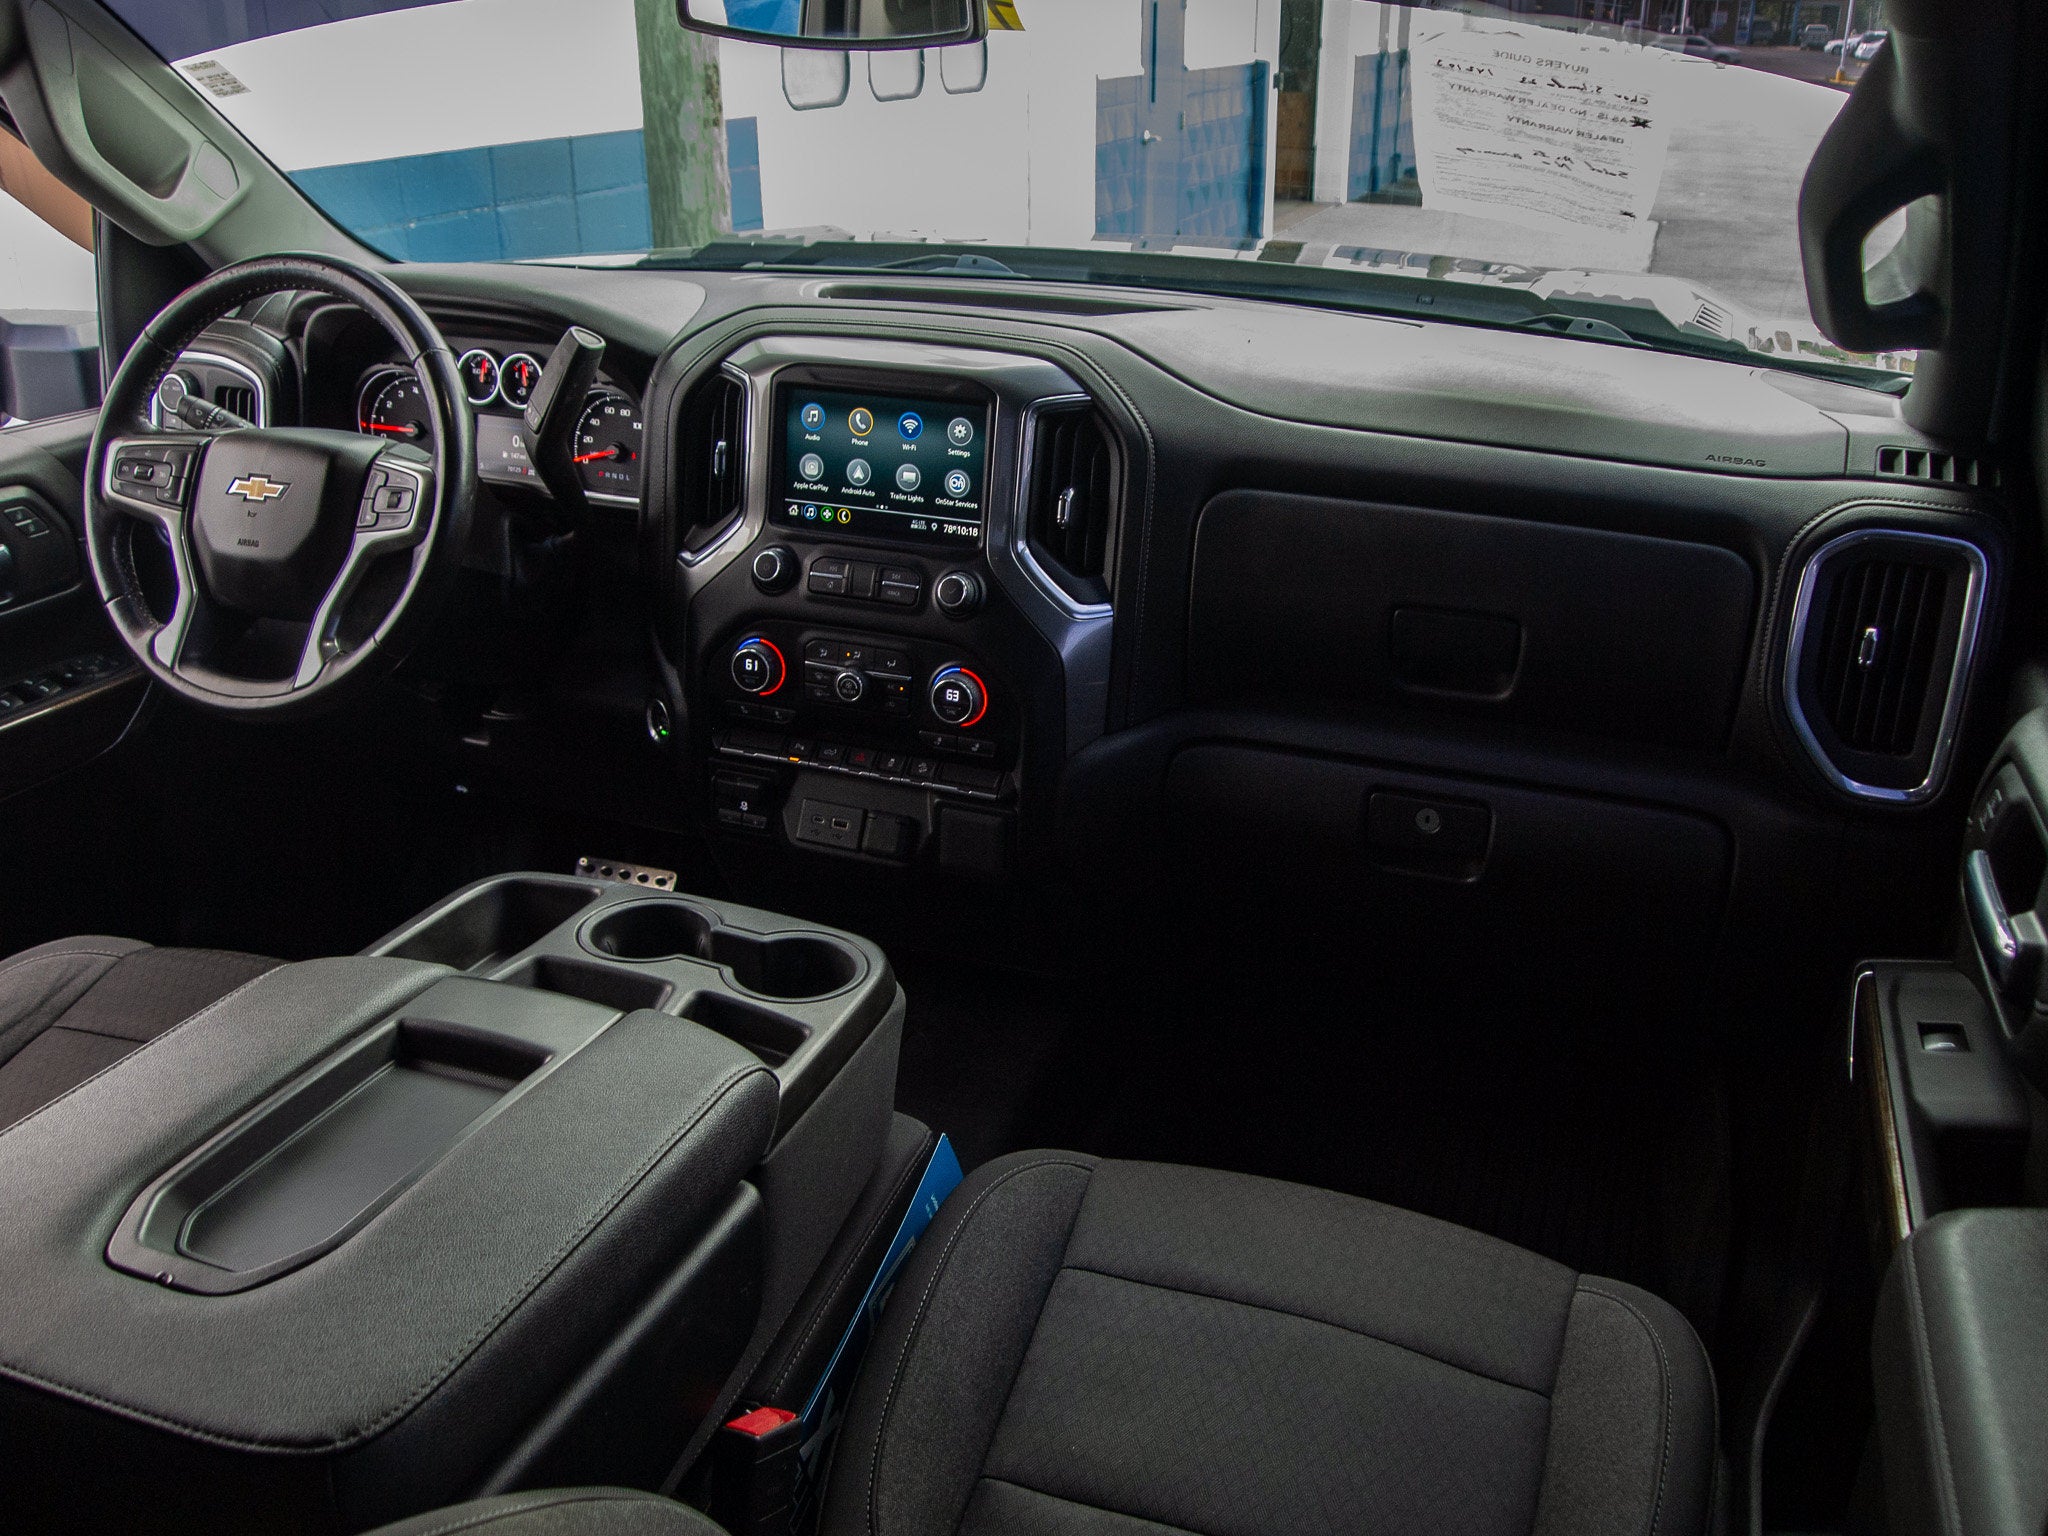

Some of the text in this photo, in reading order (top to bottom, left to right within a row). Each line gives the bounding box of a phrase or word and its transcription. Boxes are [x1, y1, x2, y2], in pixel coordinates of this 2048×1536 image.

[604, 406, 615, 415] 60
[620, 408, 631, 417] 80
[589, 418, 600, 427] 40
[583, 435, 594, 444] 20
[804, 433, 821, 442] Audio
[851, 438, 869, 447] Phone
[902, 443, 917, 452] Wi-Fi
[947, 448, 971, 458] Settings
[1705, 454, 1767, 467] AIRBAG
[793, 481, 829, 493] Apple CarPlay
[841, 487, 875, 497] Android Auto
[890, 492, 924, 503] Trailer Lights
[935, 497, 978, 510] OnStar Services
[745, 658, 758, 672] 61
[946, 688, 960, 702] 63
